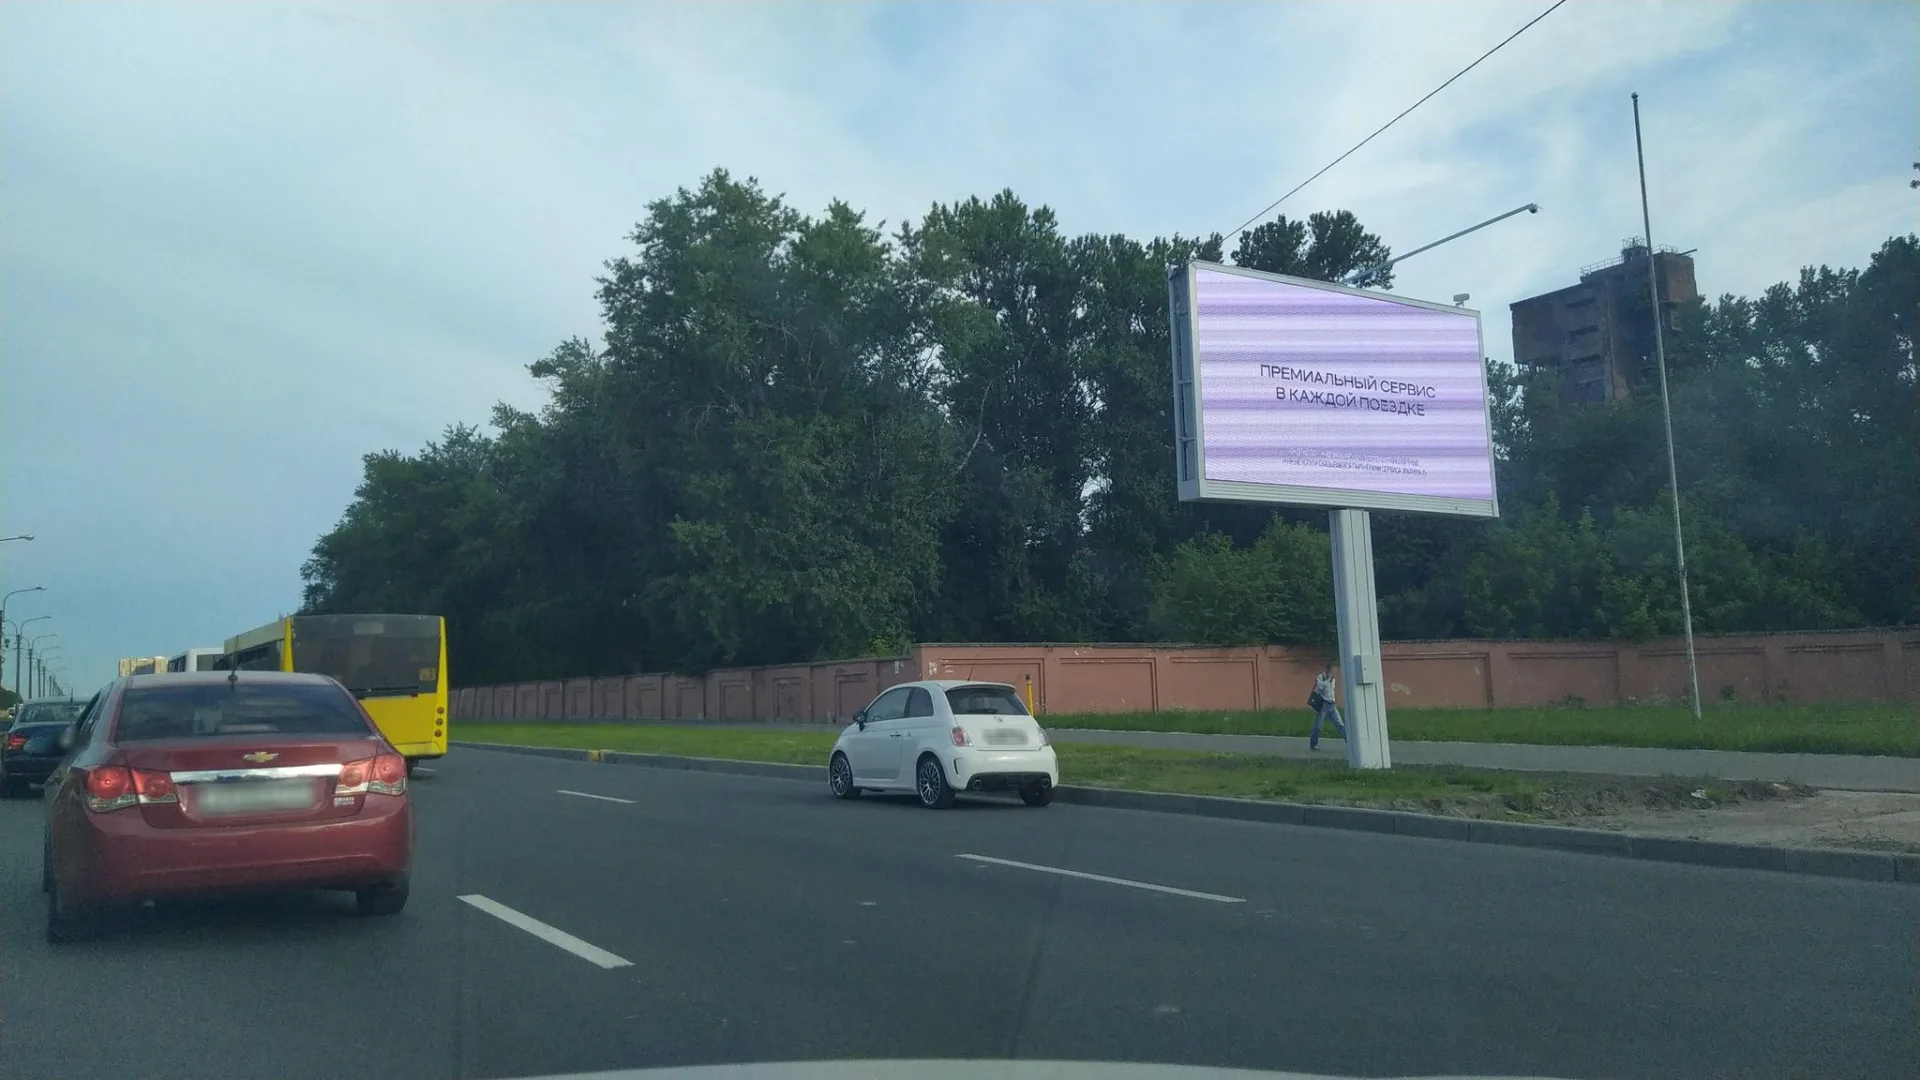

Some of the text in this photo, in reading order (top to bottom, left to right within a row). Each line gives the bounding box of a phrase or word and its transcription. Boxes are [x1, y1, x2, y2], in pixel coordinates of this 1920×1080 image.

[1260, 364, 1435, 399] ПРЕМИАЛЬНЫЙ СЕРВИС
[1276, 387, 1425, 416] В КАЖДОЙ ПОЕЗДКЕ
